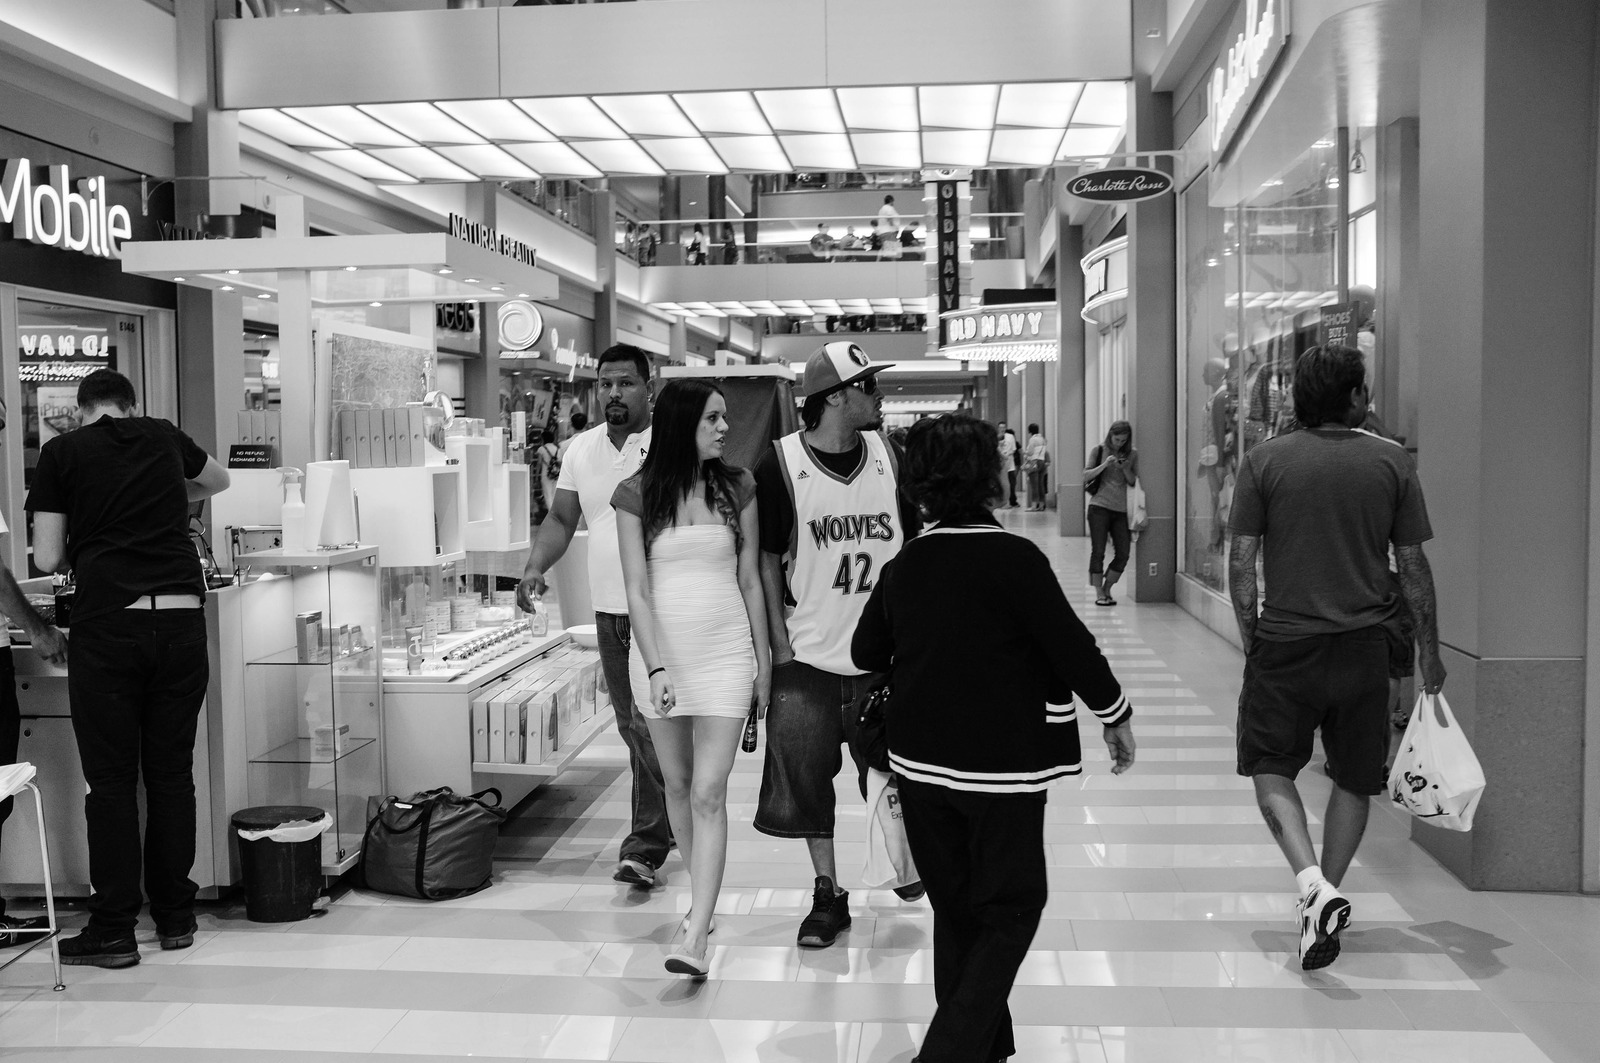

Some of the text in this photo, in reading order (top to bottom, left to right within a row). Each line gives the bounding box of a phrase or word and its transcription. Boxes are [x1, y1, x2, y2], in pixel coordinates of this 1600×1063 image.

[1072, 175, 1164, 194] Charlotte Russe
[0, 157, 132, 260] Mobile
[448, 212, 536, 267] NATURAL BEAUTY
[941, 183, 955, 309] OLD NAVY
[950, 311, 1043, 342] OLD NAVY
[806, 511, 894, 551] WOLVES
[831, 551, 873, 596] 42
[887, 793, 900, 810] p
